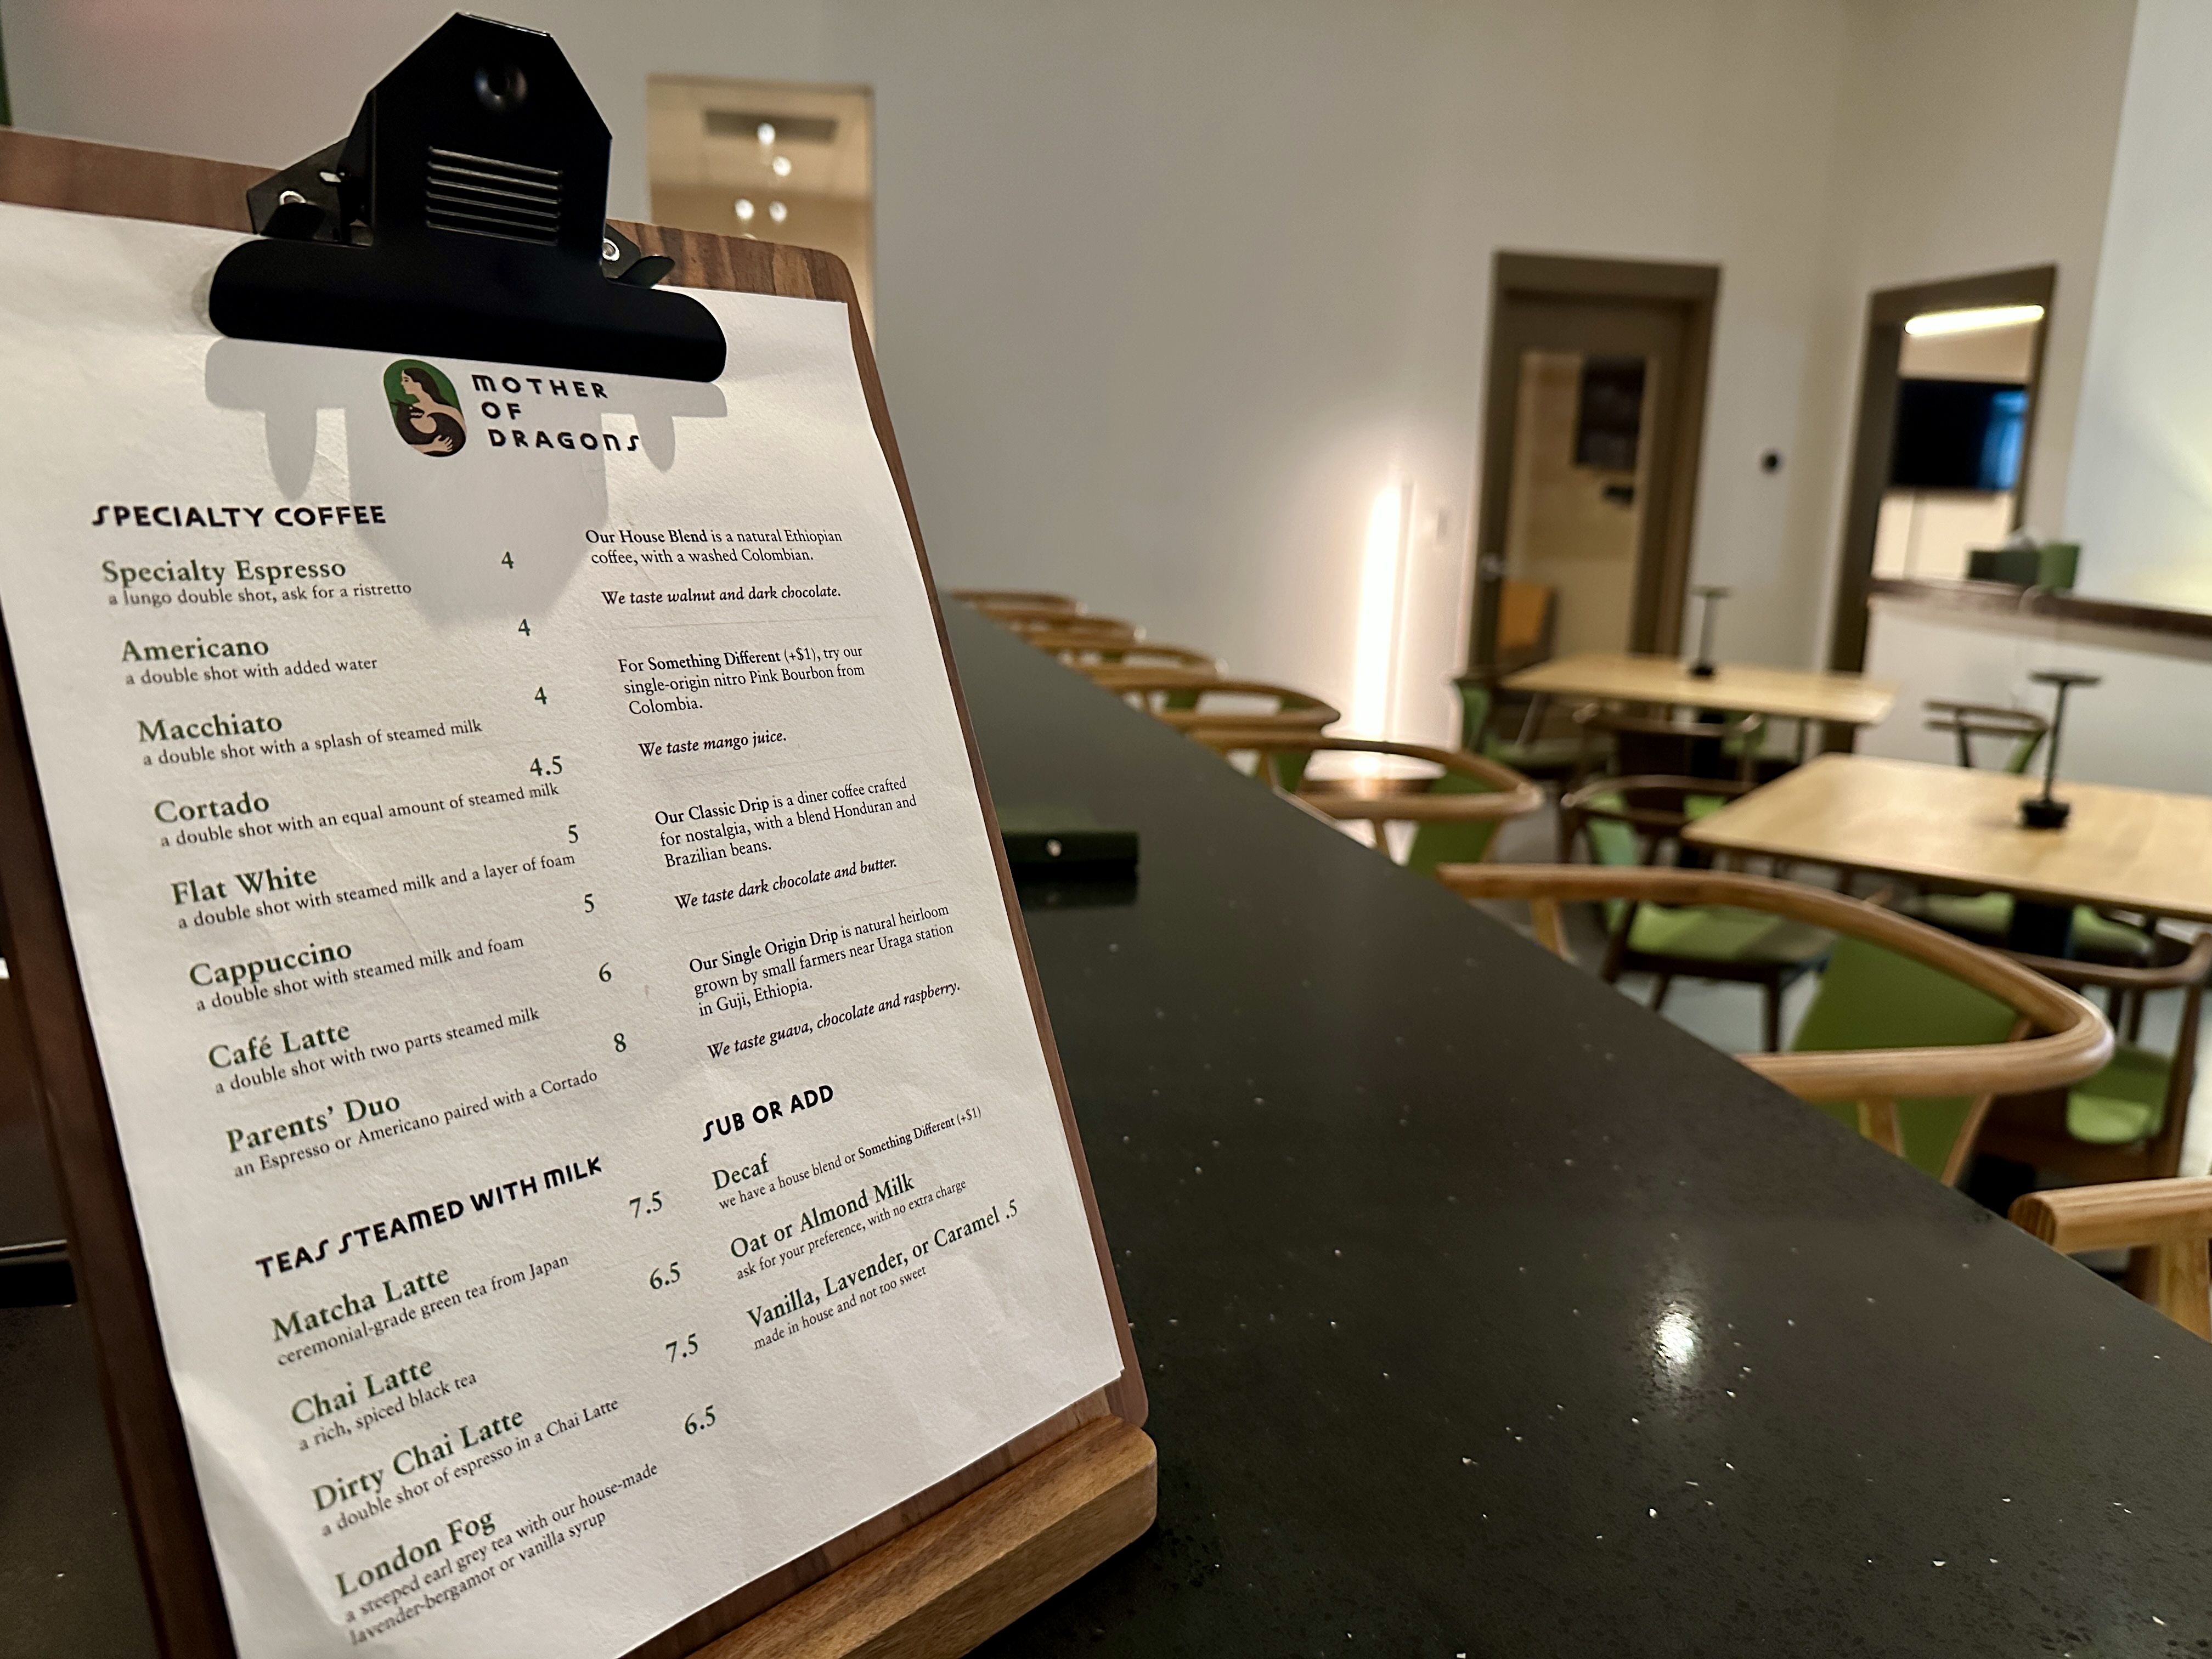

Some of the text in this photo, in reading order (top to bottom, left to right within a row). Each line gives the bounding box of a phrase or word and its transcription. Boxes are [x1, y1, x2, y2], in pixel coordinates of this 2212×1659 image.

[472, 375, 608, 399] MOTHER
[481, 401, 522, 420] OF
[487, 428, 640, 452] DRAGONS
[91, 505, 387, 528] SPECIALTY COFFEE
[585, 528, 843, 545] Our House Blend is a natural Ethiopian
[501, 551, 514, 569] 4
[591, 547, 814, 567] coffee, with a washed Colombian.
[101, 558, 346, 588] Specialty Espresso
[109, 583, 412, 608] a lungo double shot, ask for a ristretto
[600, 584, 841, 605] We taste walnut and dark chocolate.
[518, 618, 531, 637] 4
[121, 636, 269, 662] Americano
[617, 647, 862, 673] For Something Different (+$1), try our
[624, 663, 865, 696] single-origin nitro Pink Bourbon from
[534, 686, 548, 706] 4
[629, 696, 703, 715] Colombia.
[137, 713, 283, 742] Macchiato
[143, 718, 483, 766] a double shot with a splash of steamed milk
[637, 729, 787, 757] We taste mango juice.
[529, 755, 563, 777] 4.5
[154, 791, 269, 823] Cortado
[568, 824, 579, 844] 5
[170, 866, 318, 906] Flat White
[584, 893, 595, 913] 5
[689, 906, 950, 973] Our Single Origin Drip is natural heirloom
[190, 943, 352, 987] Cappuccino
[599, 962, 612, 983] 6
[694, 924, 954, 999] grown by small farmers near Uraga station
[698, 977, 812, 1017] in Guji, Ethiopia.
[706, 983, 960, 1059] We taste guava, chocolate and raspberry.
[208, 1025, 351, 1069] Café Latte
[613, 1032, 627, 1053] 8
[235, 1069, 597, 1178] an Espresso or Americano paired with a Cortado
[343, 1097, 400, 1123] Duo
[702, 1085, 833, 1143] SUB OR ADD
[711, 1152, 770, 1191] Decaf
[255, 1156, 602, 1279] TEAS STEAMED WITH MILK
[629, 1190, 663, 1219] 7.5
[730, 1172, 915, 1258] Oat or Almond Milk
[737, 1181, 966, 1280] ask for your preference, with no extra charge
[650, 1261, 681, 1290] 6.5
[746, 1199, 1017, 1328] Vanilla, Lavender, or Caramel .5
[271, 1269, 450, 1342] Matcha Latte
[277, 1256, 569, 1366] ceremonial-grade green tea from Japan
[665, 1333, 698, 1363] 7.5
[291, 1361, 433, 1424] Chai Latte
[684, 1404, 716, 1435] 6.5
[312, 1412, 523, 1512] Dirty Chai Latte
[335, 1512, 495, 1598] London Fog
